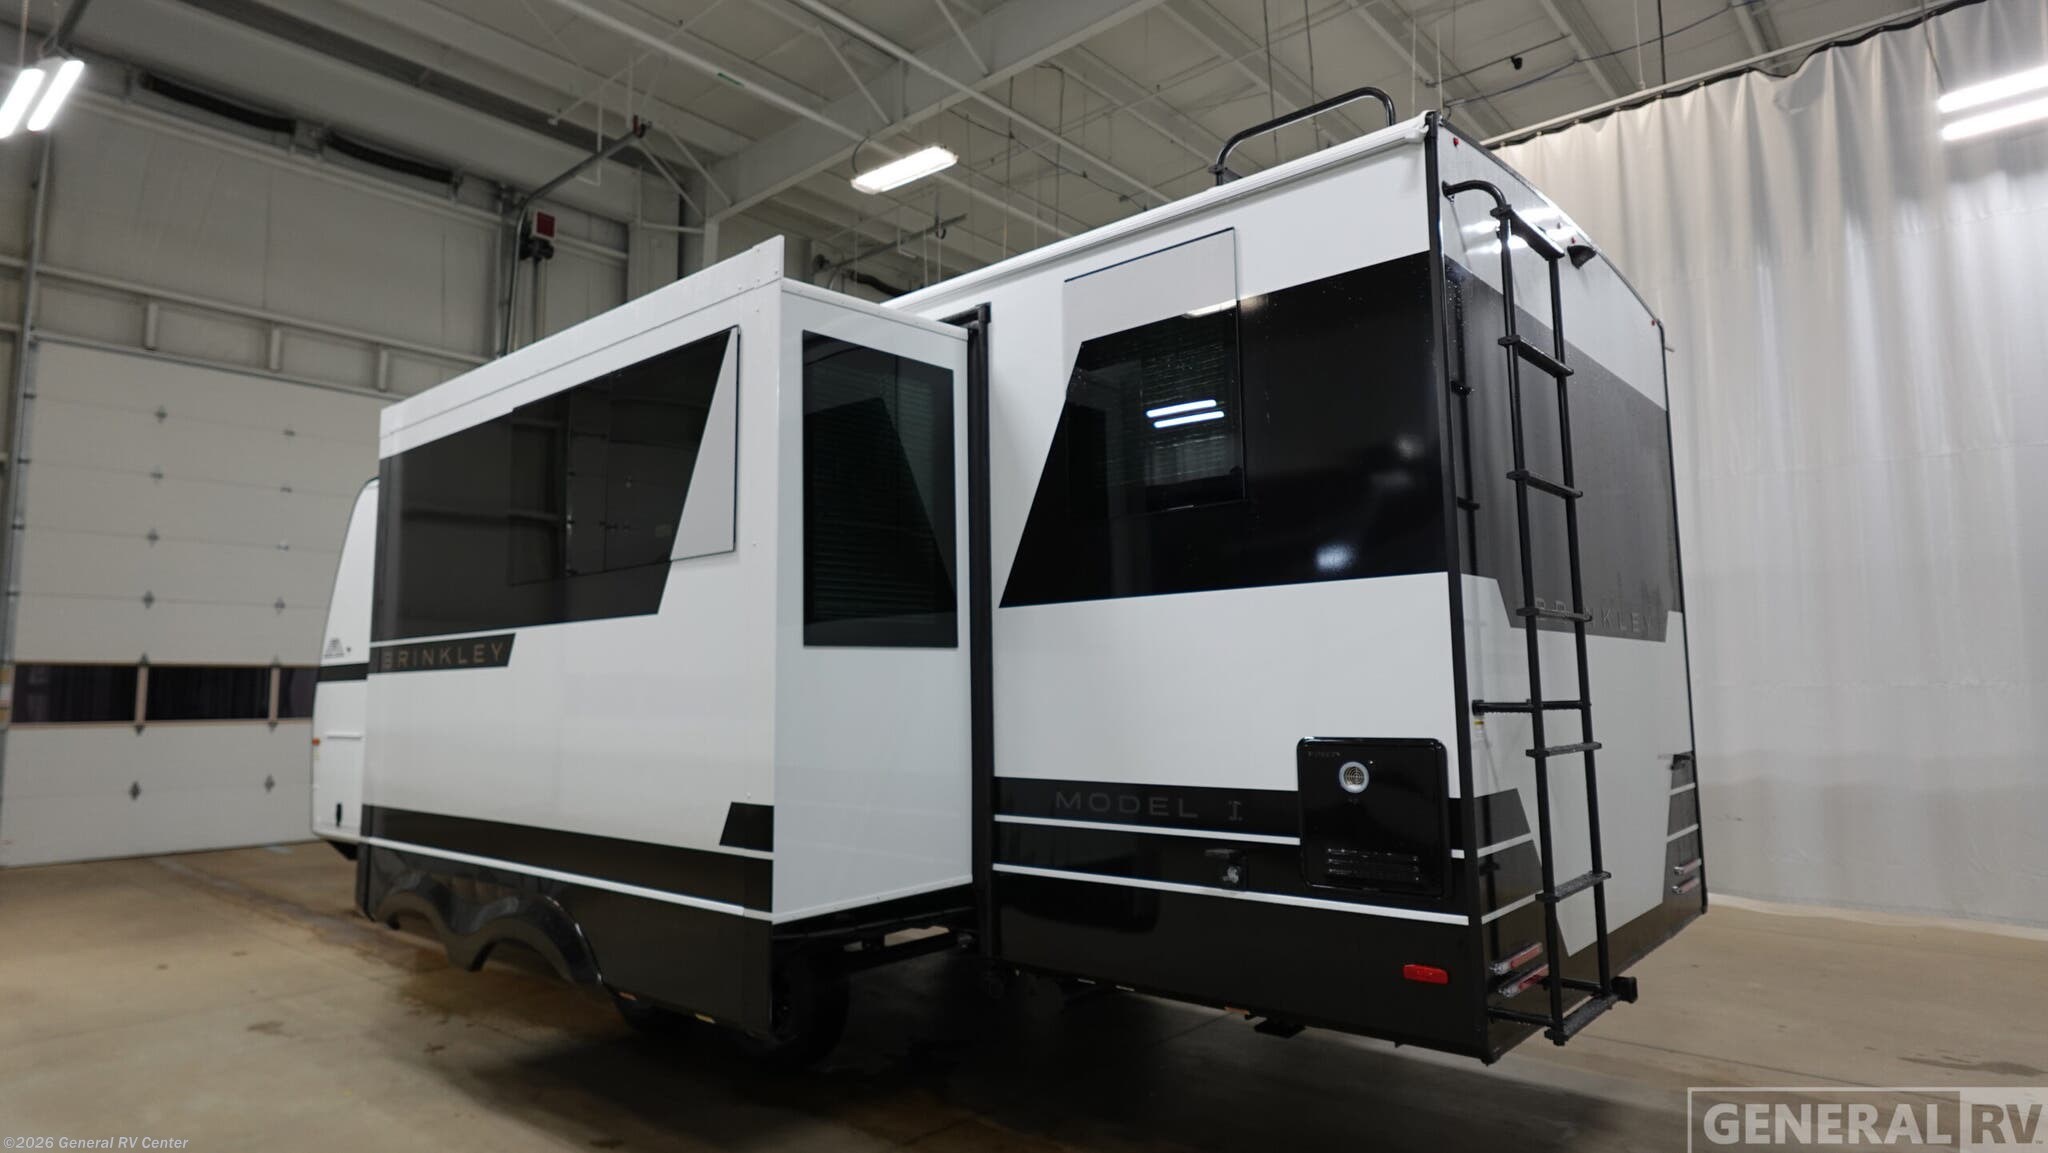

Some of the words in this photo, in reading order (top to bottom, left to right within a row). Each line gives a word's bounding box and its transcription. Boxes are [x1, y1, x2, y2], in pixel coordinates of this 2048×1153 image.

[383, 643, 504, 668] BRINKLEY
[1056, 791, 1198, 817] MODEL
[1227, 801, 1244, 821] I
